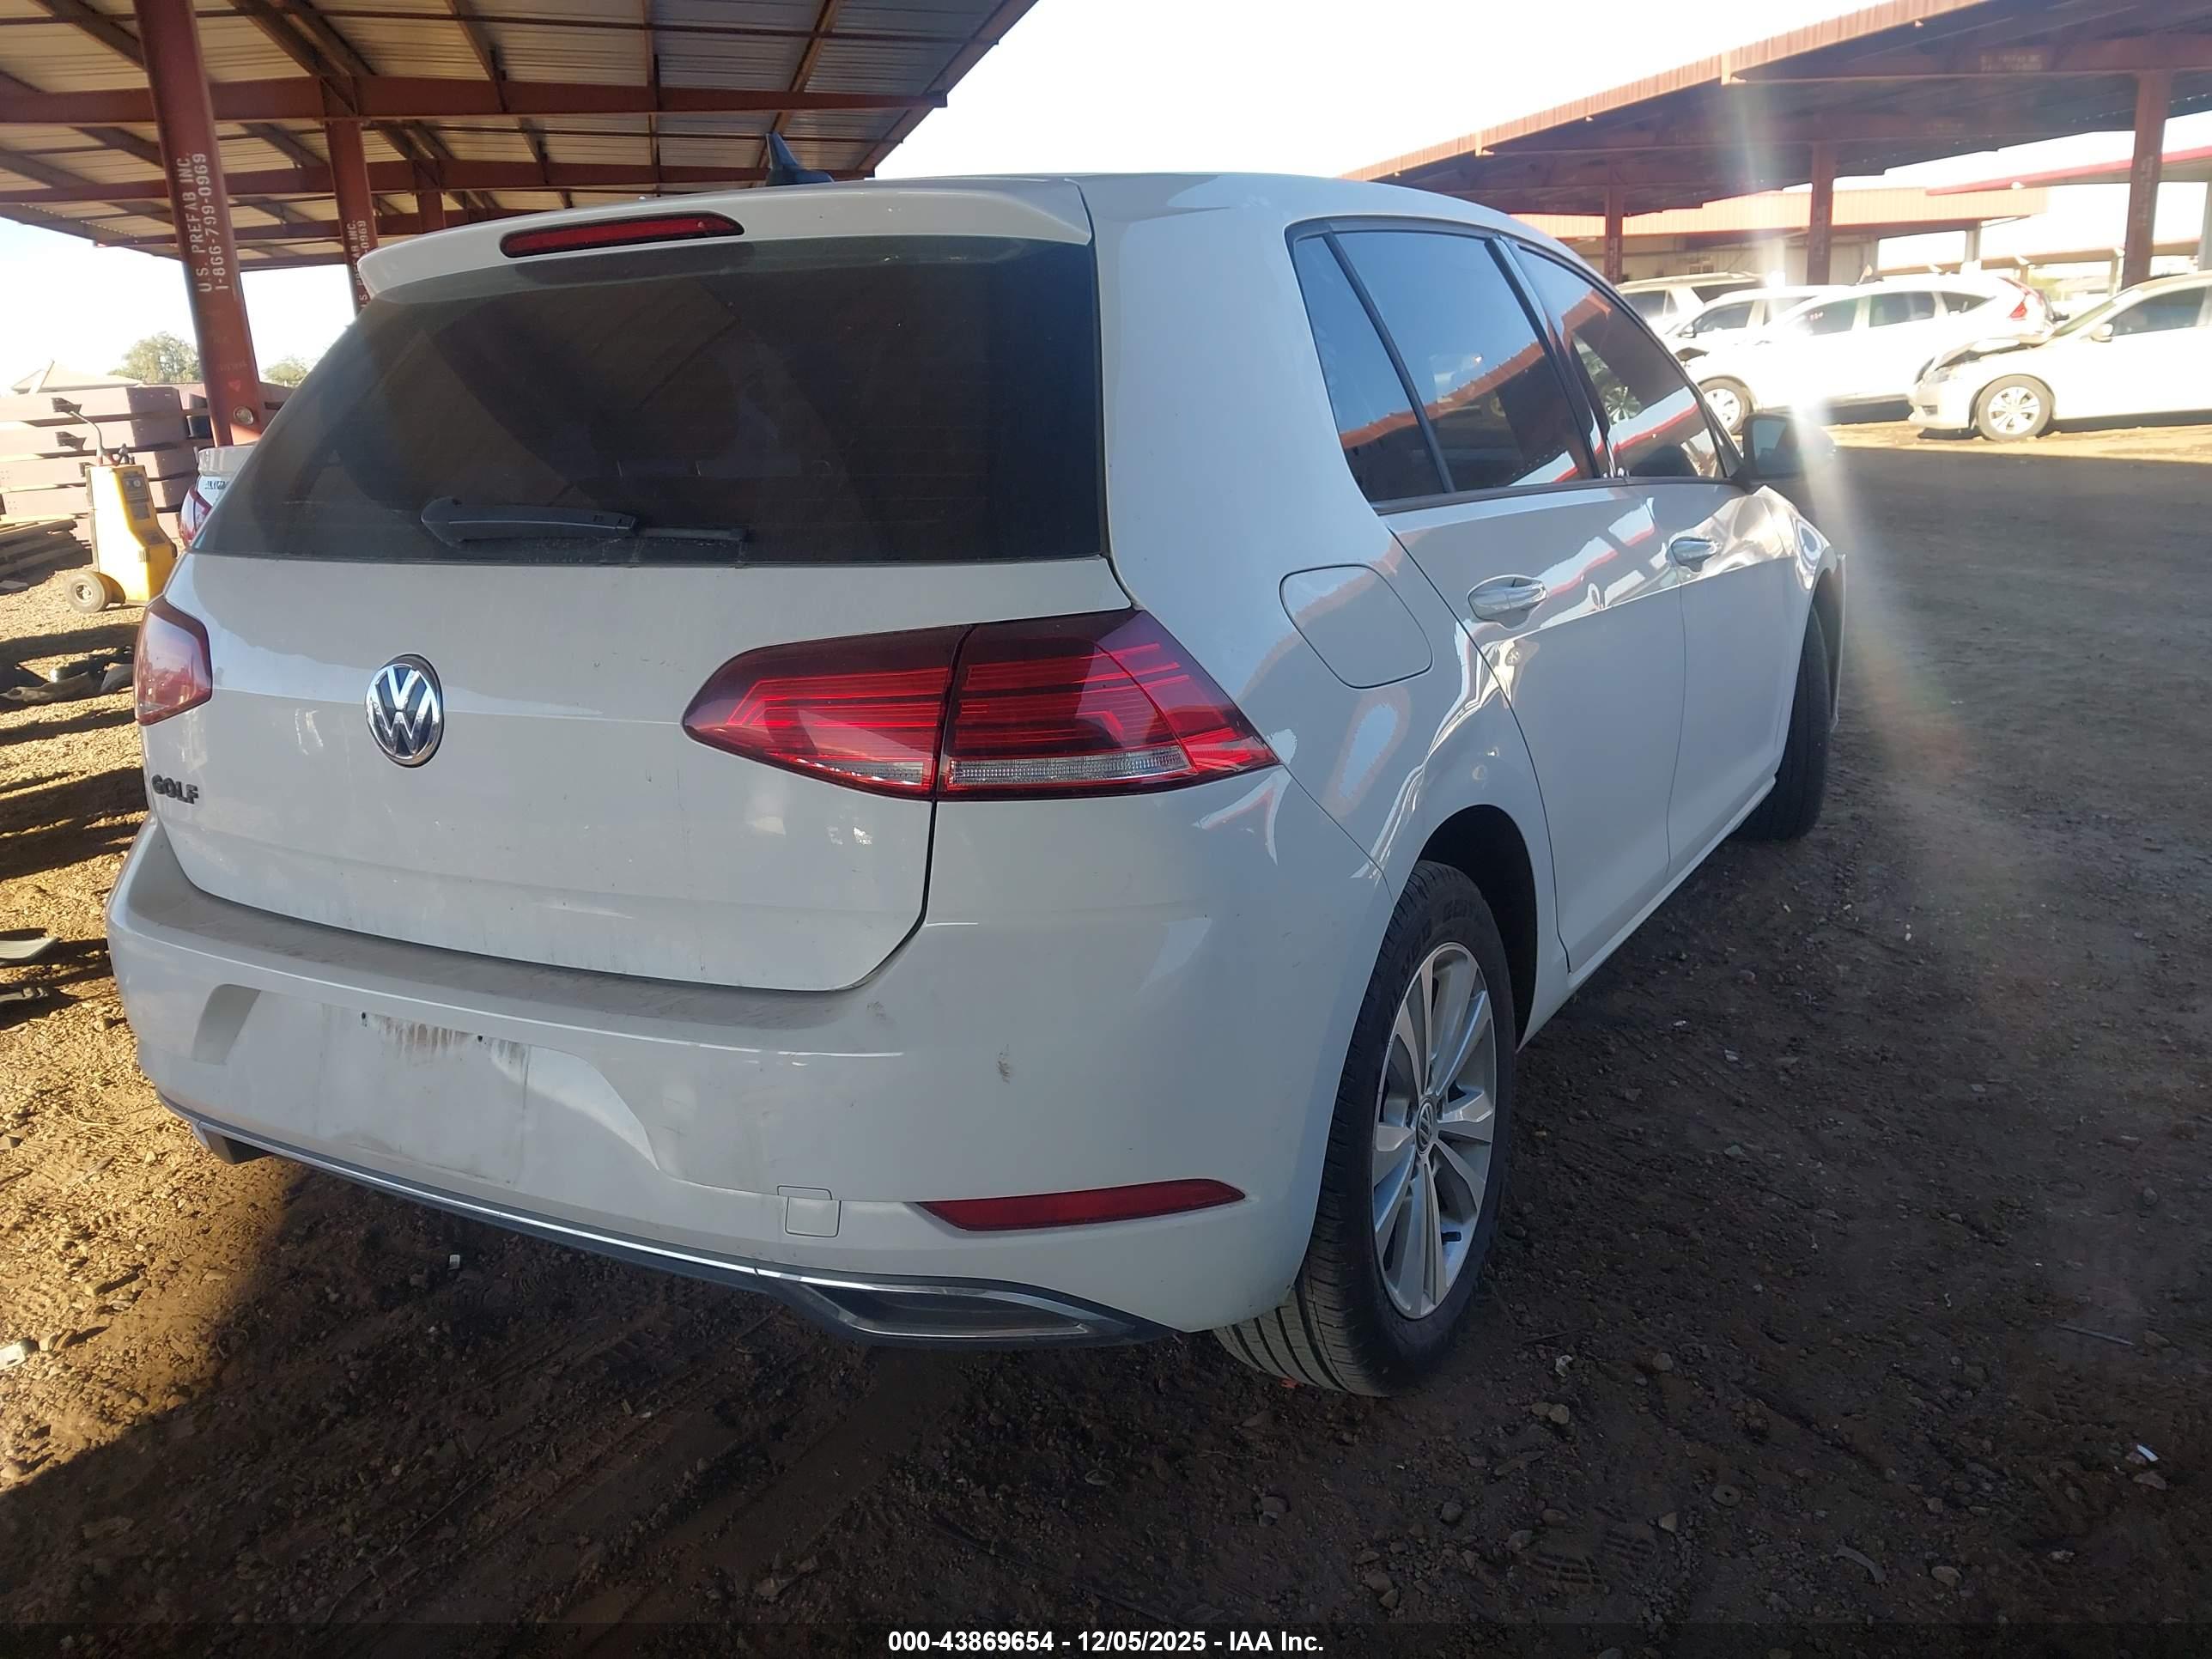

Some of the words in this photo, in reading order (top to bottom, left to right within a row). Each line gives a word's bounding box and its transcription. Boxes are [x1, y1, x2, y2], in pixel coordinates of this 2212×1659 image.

[176, 152, 195, 183] INC.
[182, 191, 206, 253] PREFAB
[191, 153, 229, 290] 1-866-799-0969
[151, 774, 199, 805] GOLF
